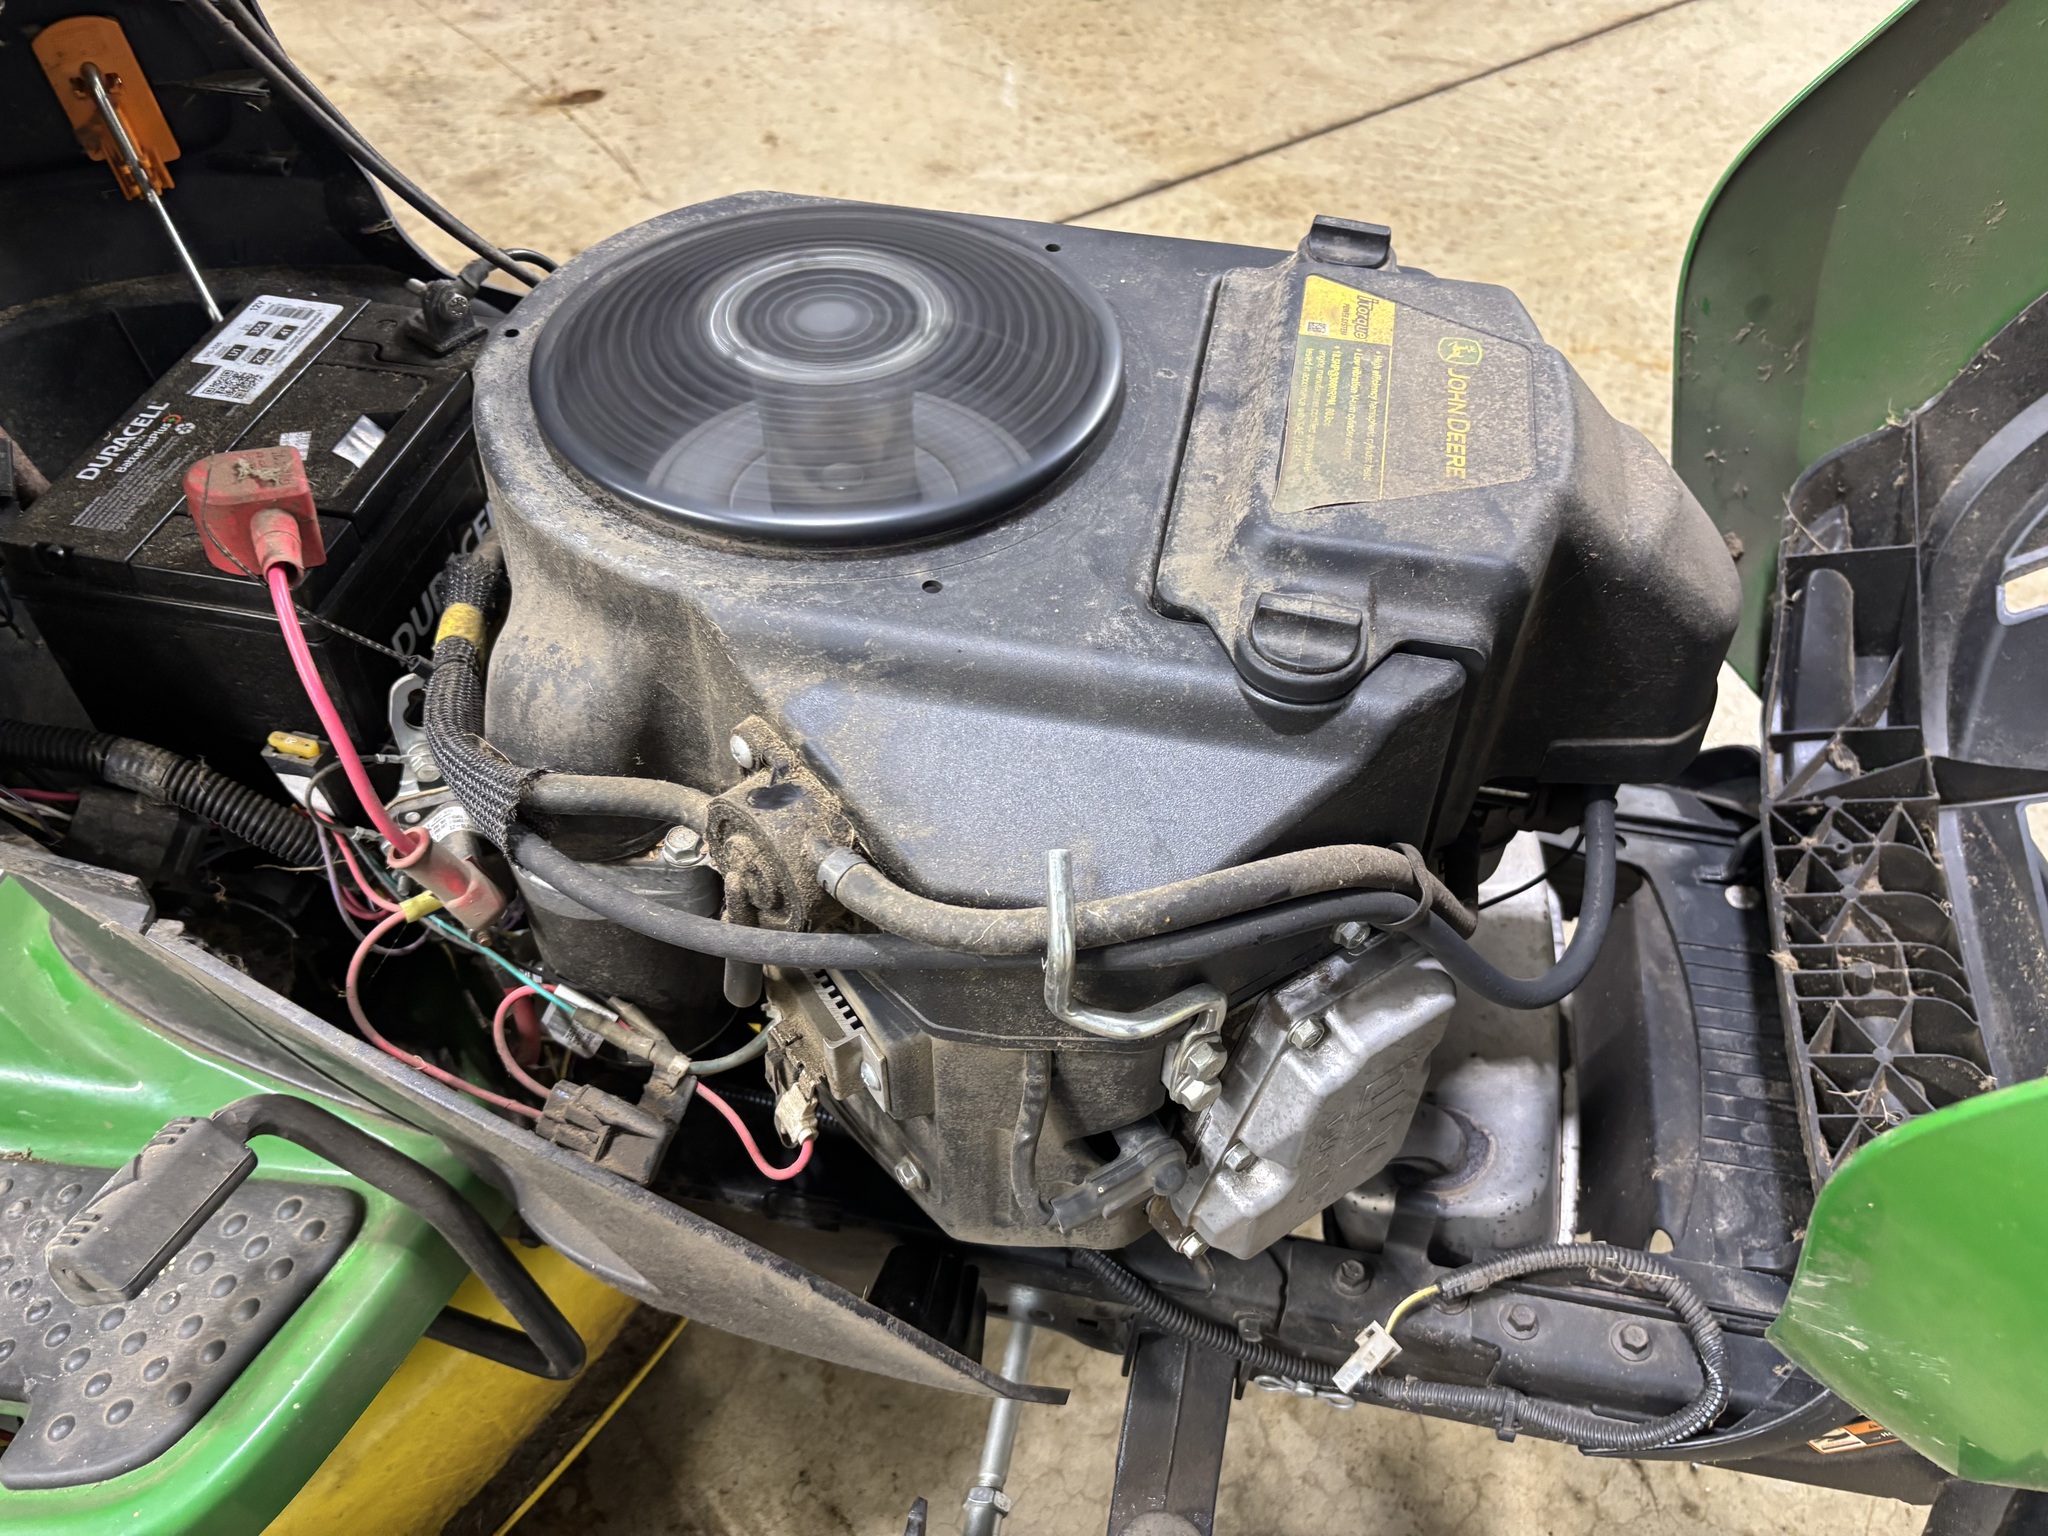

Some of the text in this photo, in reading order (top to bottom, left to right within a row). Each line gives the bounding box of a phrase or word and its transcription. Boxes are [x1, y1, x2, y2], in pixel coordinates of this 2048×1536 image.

[250, 300, 265, 311] 12V
[1354, 295, 1379, 341] iTorque
[1352, 353, 1363, 365] Low
[1370, 356, 1383, 367] High
[1349, 367, 1362, 392] vibration
[1367, 371, 1381, 399] efficiency
[1445, 369, 1470, 478] JOHN DEERE
[75, 400, 170, 481] DURACELL
[114, 422, 172, 474] BatteriesPlus
